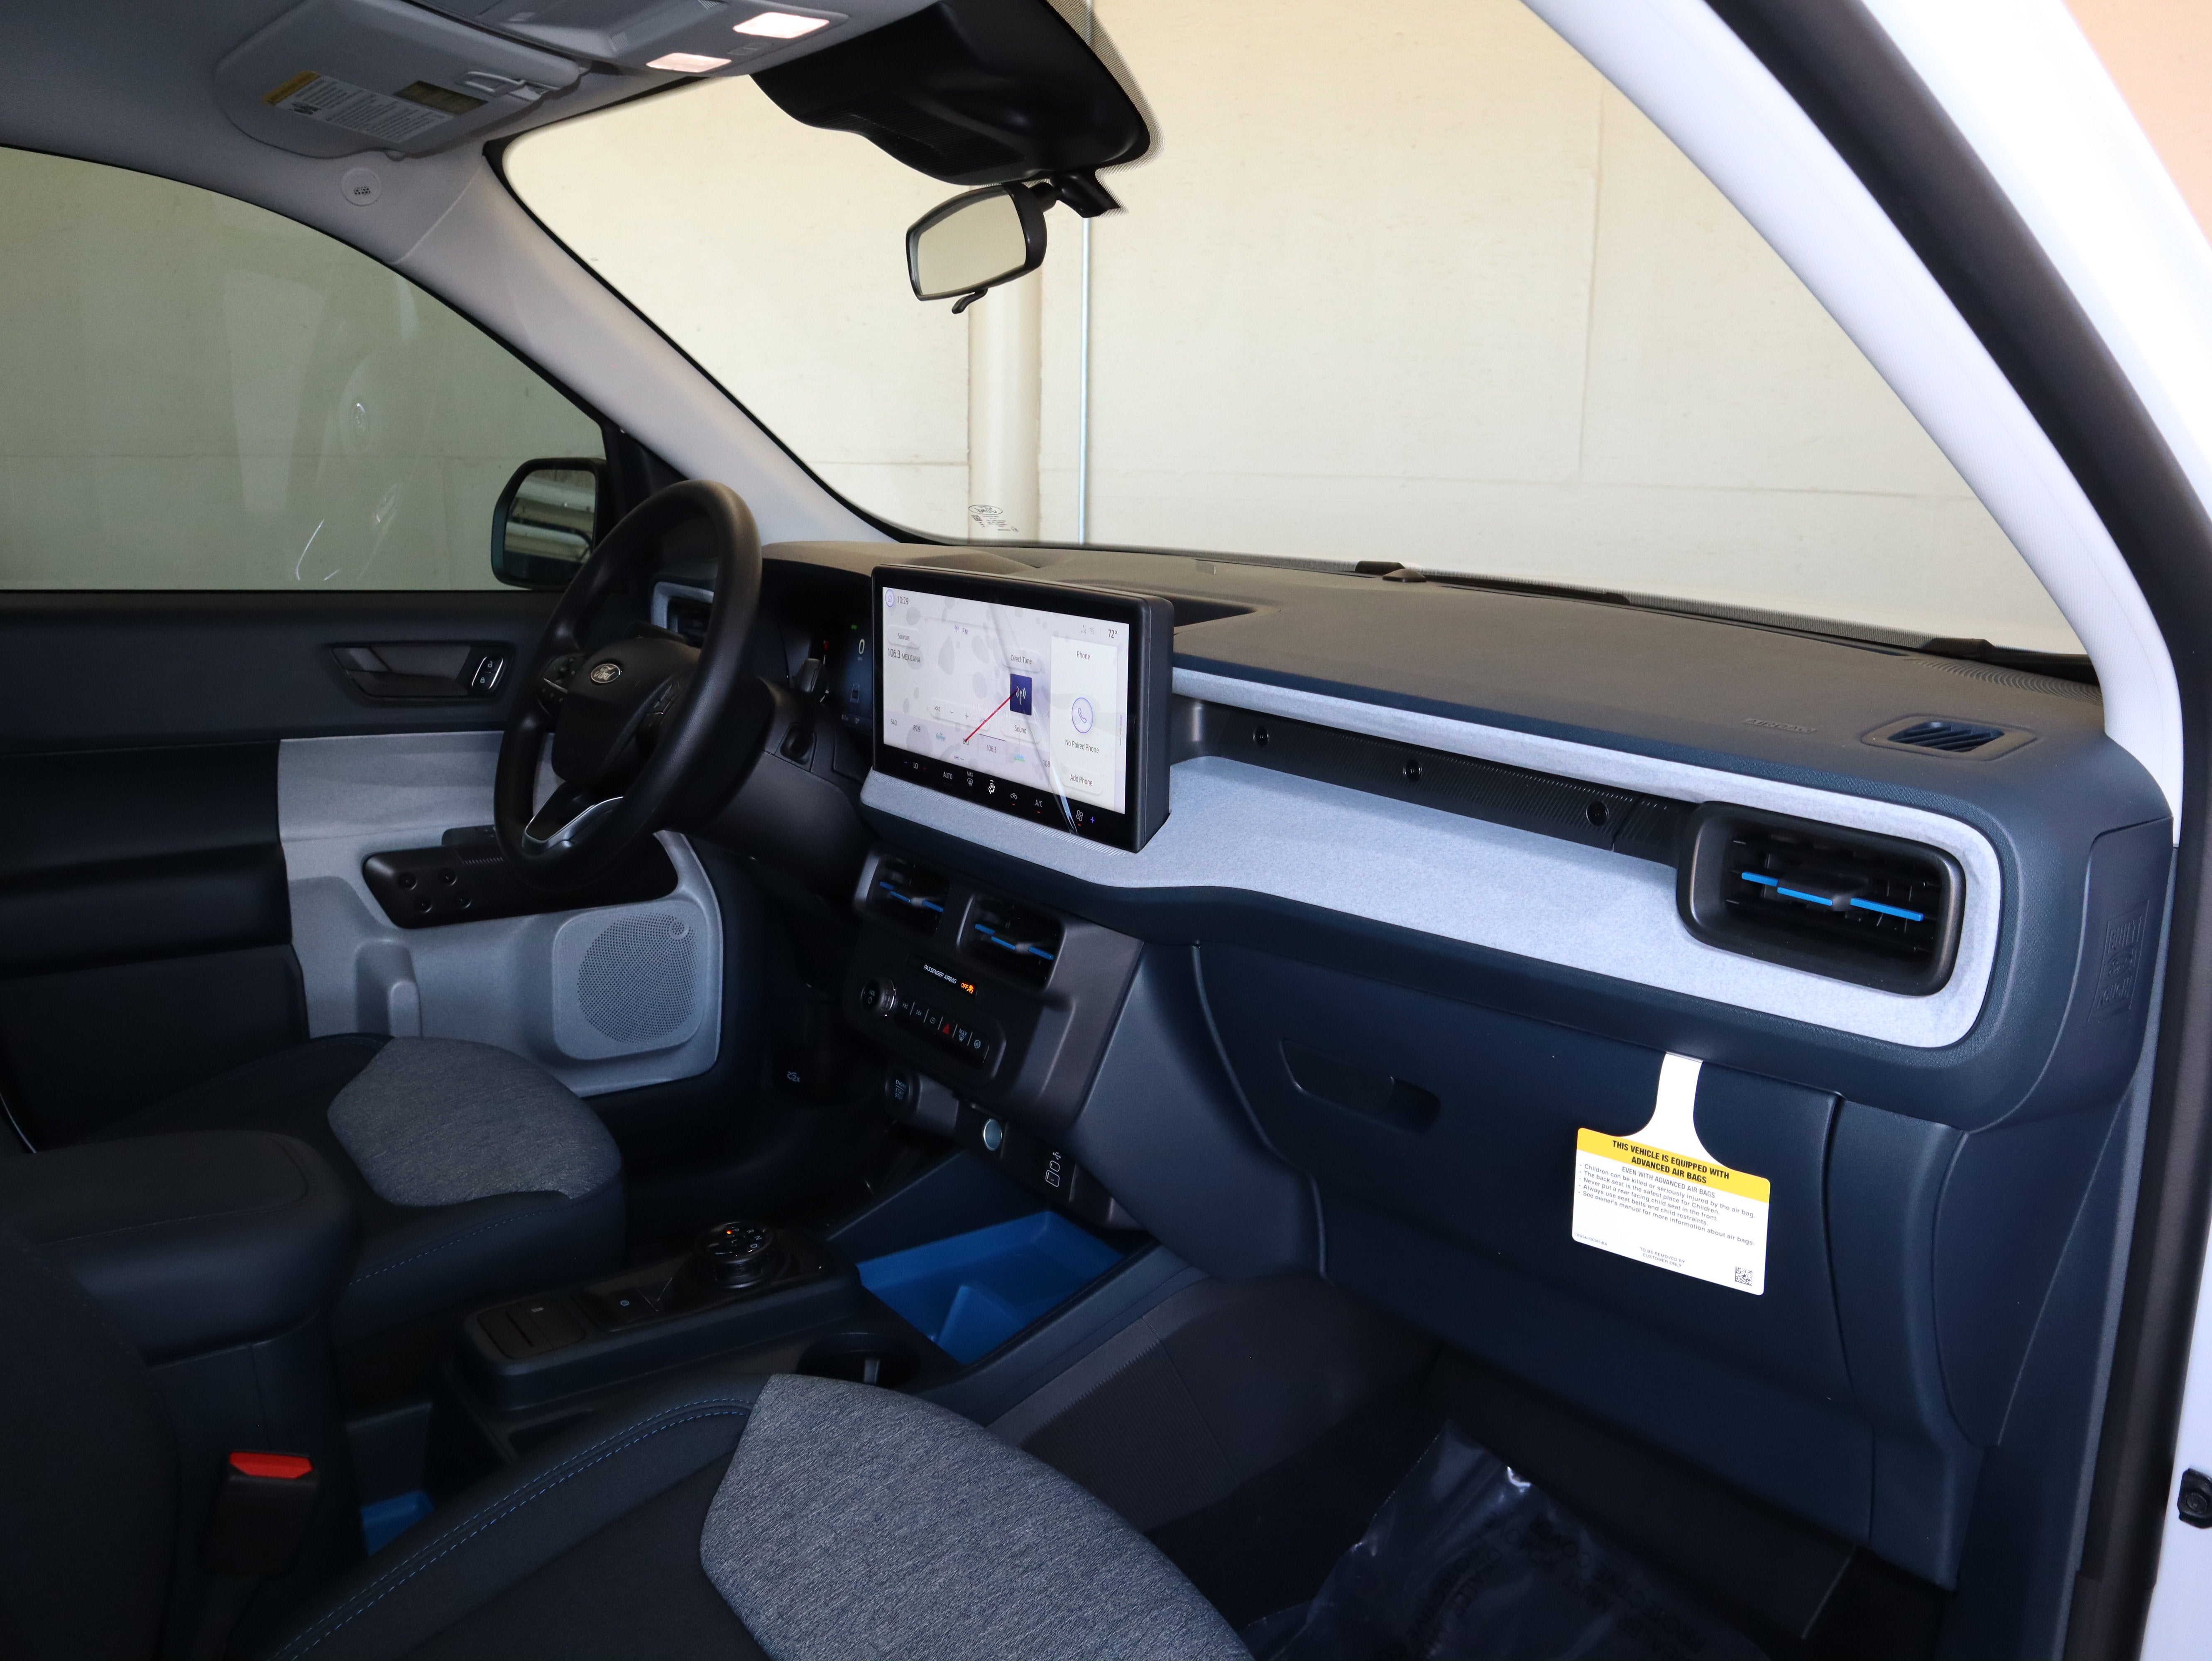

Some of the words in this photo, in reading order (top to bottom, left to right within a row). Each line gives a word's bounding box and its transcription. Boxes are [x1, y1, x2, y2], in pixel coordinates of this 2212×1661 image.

[897, 596, 909, 605] 10:29
[898, 633, 910, 641] Sources
[1108, 629, 1117, 638] 72°
[859, 639, 865, 655] 0
[888, 648, 900, 659] 106.3
[902, 652, 921, 663] MEXICANA
[1011, 654, 1021, 663] Direct
[1022, 656, 1032, 664] Tune
[1077, 651, 1090, 660] Phone
[594, 665, 616, 681] Ford
[1014, 725, 1027, 734] Sound
[987, 745, 997, 753] 106.3
[1072, 740, 1085, 750] Paired
[1086, 744, 1099, 754] Phone
[943, 772, 953, 780] AUTO
[1070, 774, 1079, 782] Add
[1079, 776, 1093, 786] Phone
[923, 964, 944, 978] PASSENGER
[943, 974, 957, 984] AIRBAG
[959, 1029, 967, 1037] MAX
[1613, 1140, 1628, 1151] THIS
[1631, 1145, 1659, 1159] VEHICLE
[1671, 1157, 1707, 1173] EQUIPPED
[1710, 1168, 1729, 1179] WITH
[1632, 1156, 1670, 1173] ADVANCED
[1672, 1168, 1684, 1177] AIR
[1687, 1172, 1706, 1183] BAGS
[1622, 1166, 1637, 1176] EVEN
[1638, 1171, 1653, 1181] WITH
[1655, 1176, 1686, 1190] ADVANCED
[1699, 1188, 1715, 1198] BAGS
[1584, 1164, 1609, 1175] Children
[1632, 1178, 1647, 1187] killed
[1657, 1186, 1685, 1198] seriously
[1687, 1194, 1708, 1204] injured
[1742, 1210, 1755, 1218] bag.
[1596, 1174, 1610, 1183] back
[1643, 1189, 1661, 1198] safest
[1692, 1202, 1720, 1215] Children.
[1583, 1184, 1604, 1195] Always
[1632, 1199, 1646, 1207] belts
[1677, 1213, 1708, 1225] restraints.
[1584, 1177, 1600, 1186] Never
[1631, 1192, 1649, 1203] facing
[1701, 1212, 1718, 1221] front.
[1595, 1196, 1617, 1206] owner's
[1619, 1203, 1641, 1213] manual
[1670, 1217, 1705, 1232] information
[1707, 1229, 1725, 1237] about
[1737, 1236, 1754, 1245] bags.
[1642, 1253, 1668, 1264] CUSTOMER
[1654, 1252, 1678, 1262] REMOVED
